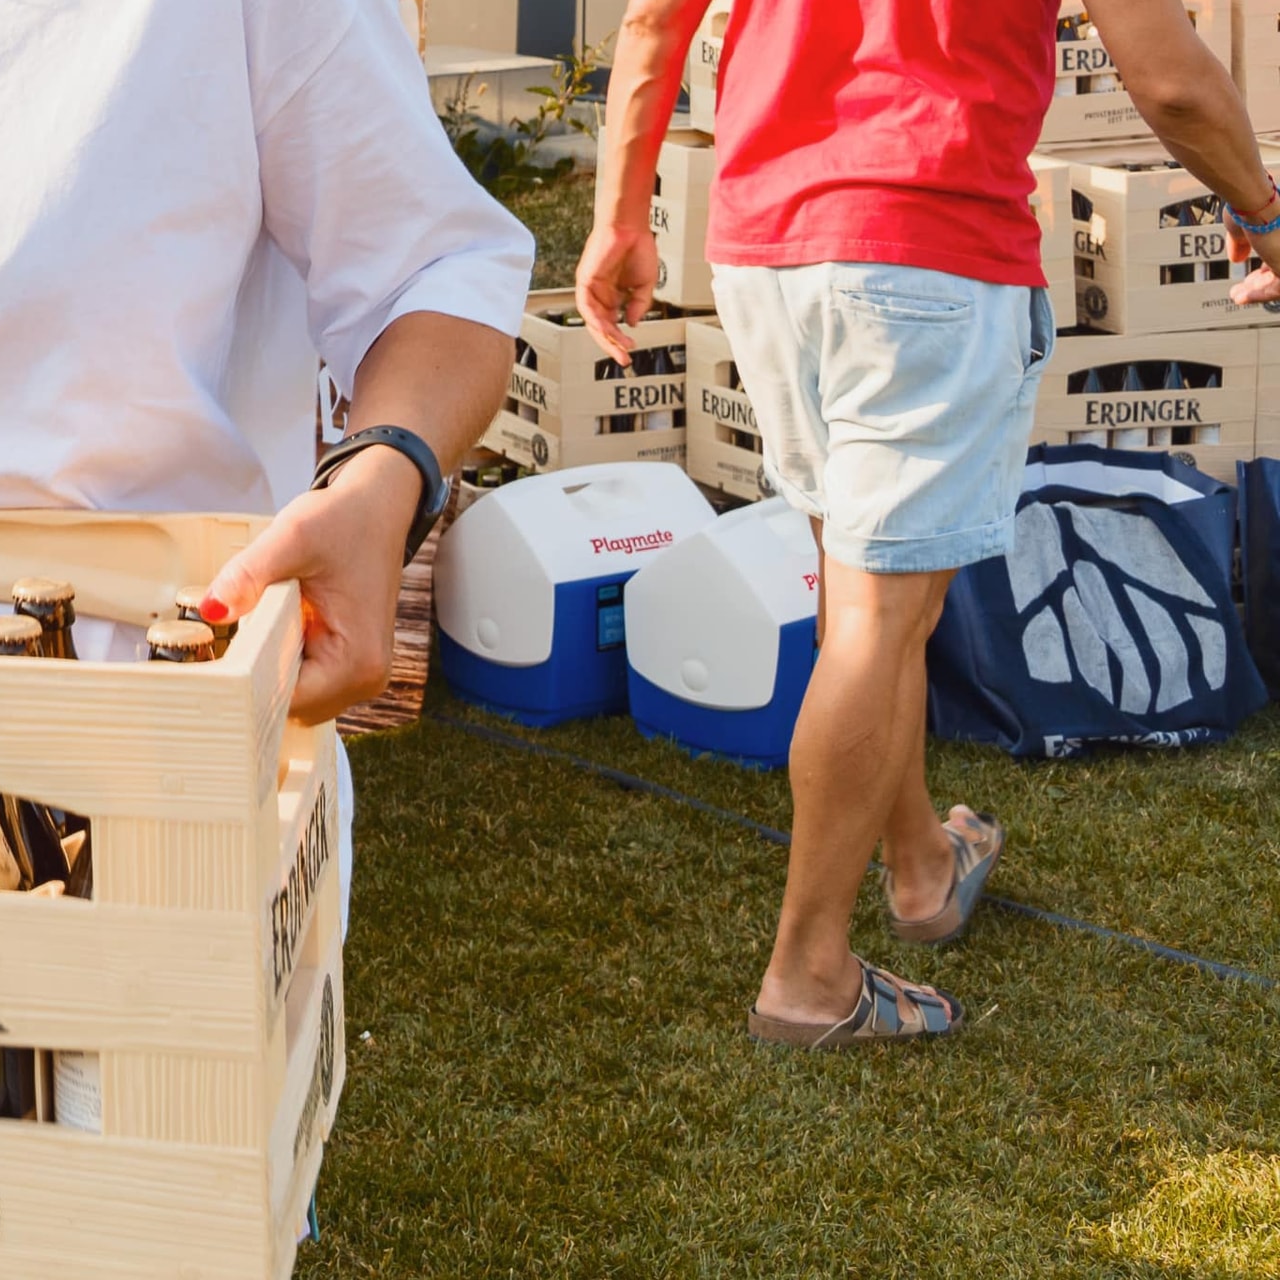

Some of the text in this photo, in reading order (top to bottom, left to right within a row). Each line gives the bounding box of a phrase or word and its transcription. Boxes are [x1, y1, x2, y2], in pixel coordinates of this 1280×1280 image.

[1085, 397, 1203, 428] ERDINGER
[590, 529, 673, 554] Playmate
[271, 781, 329, 997] ERDINGER
